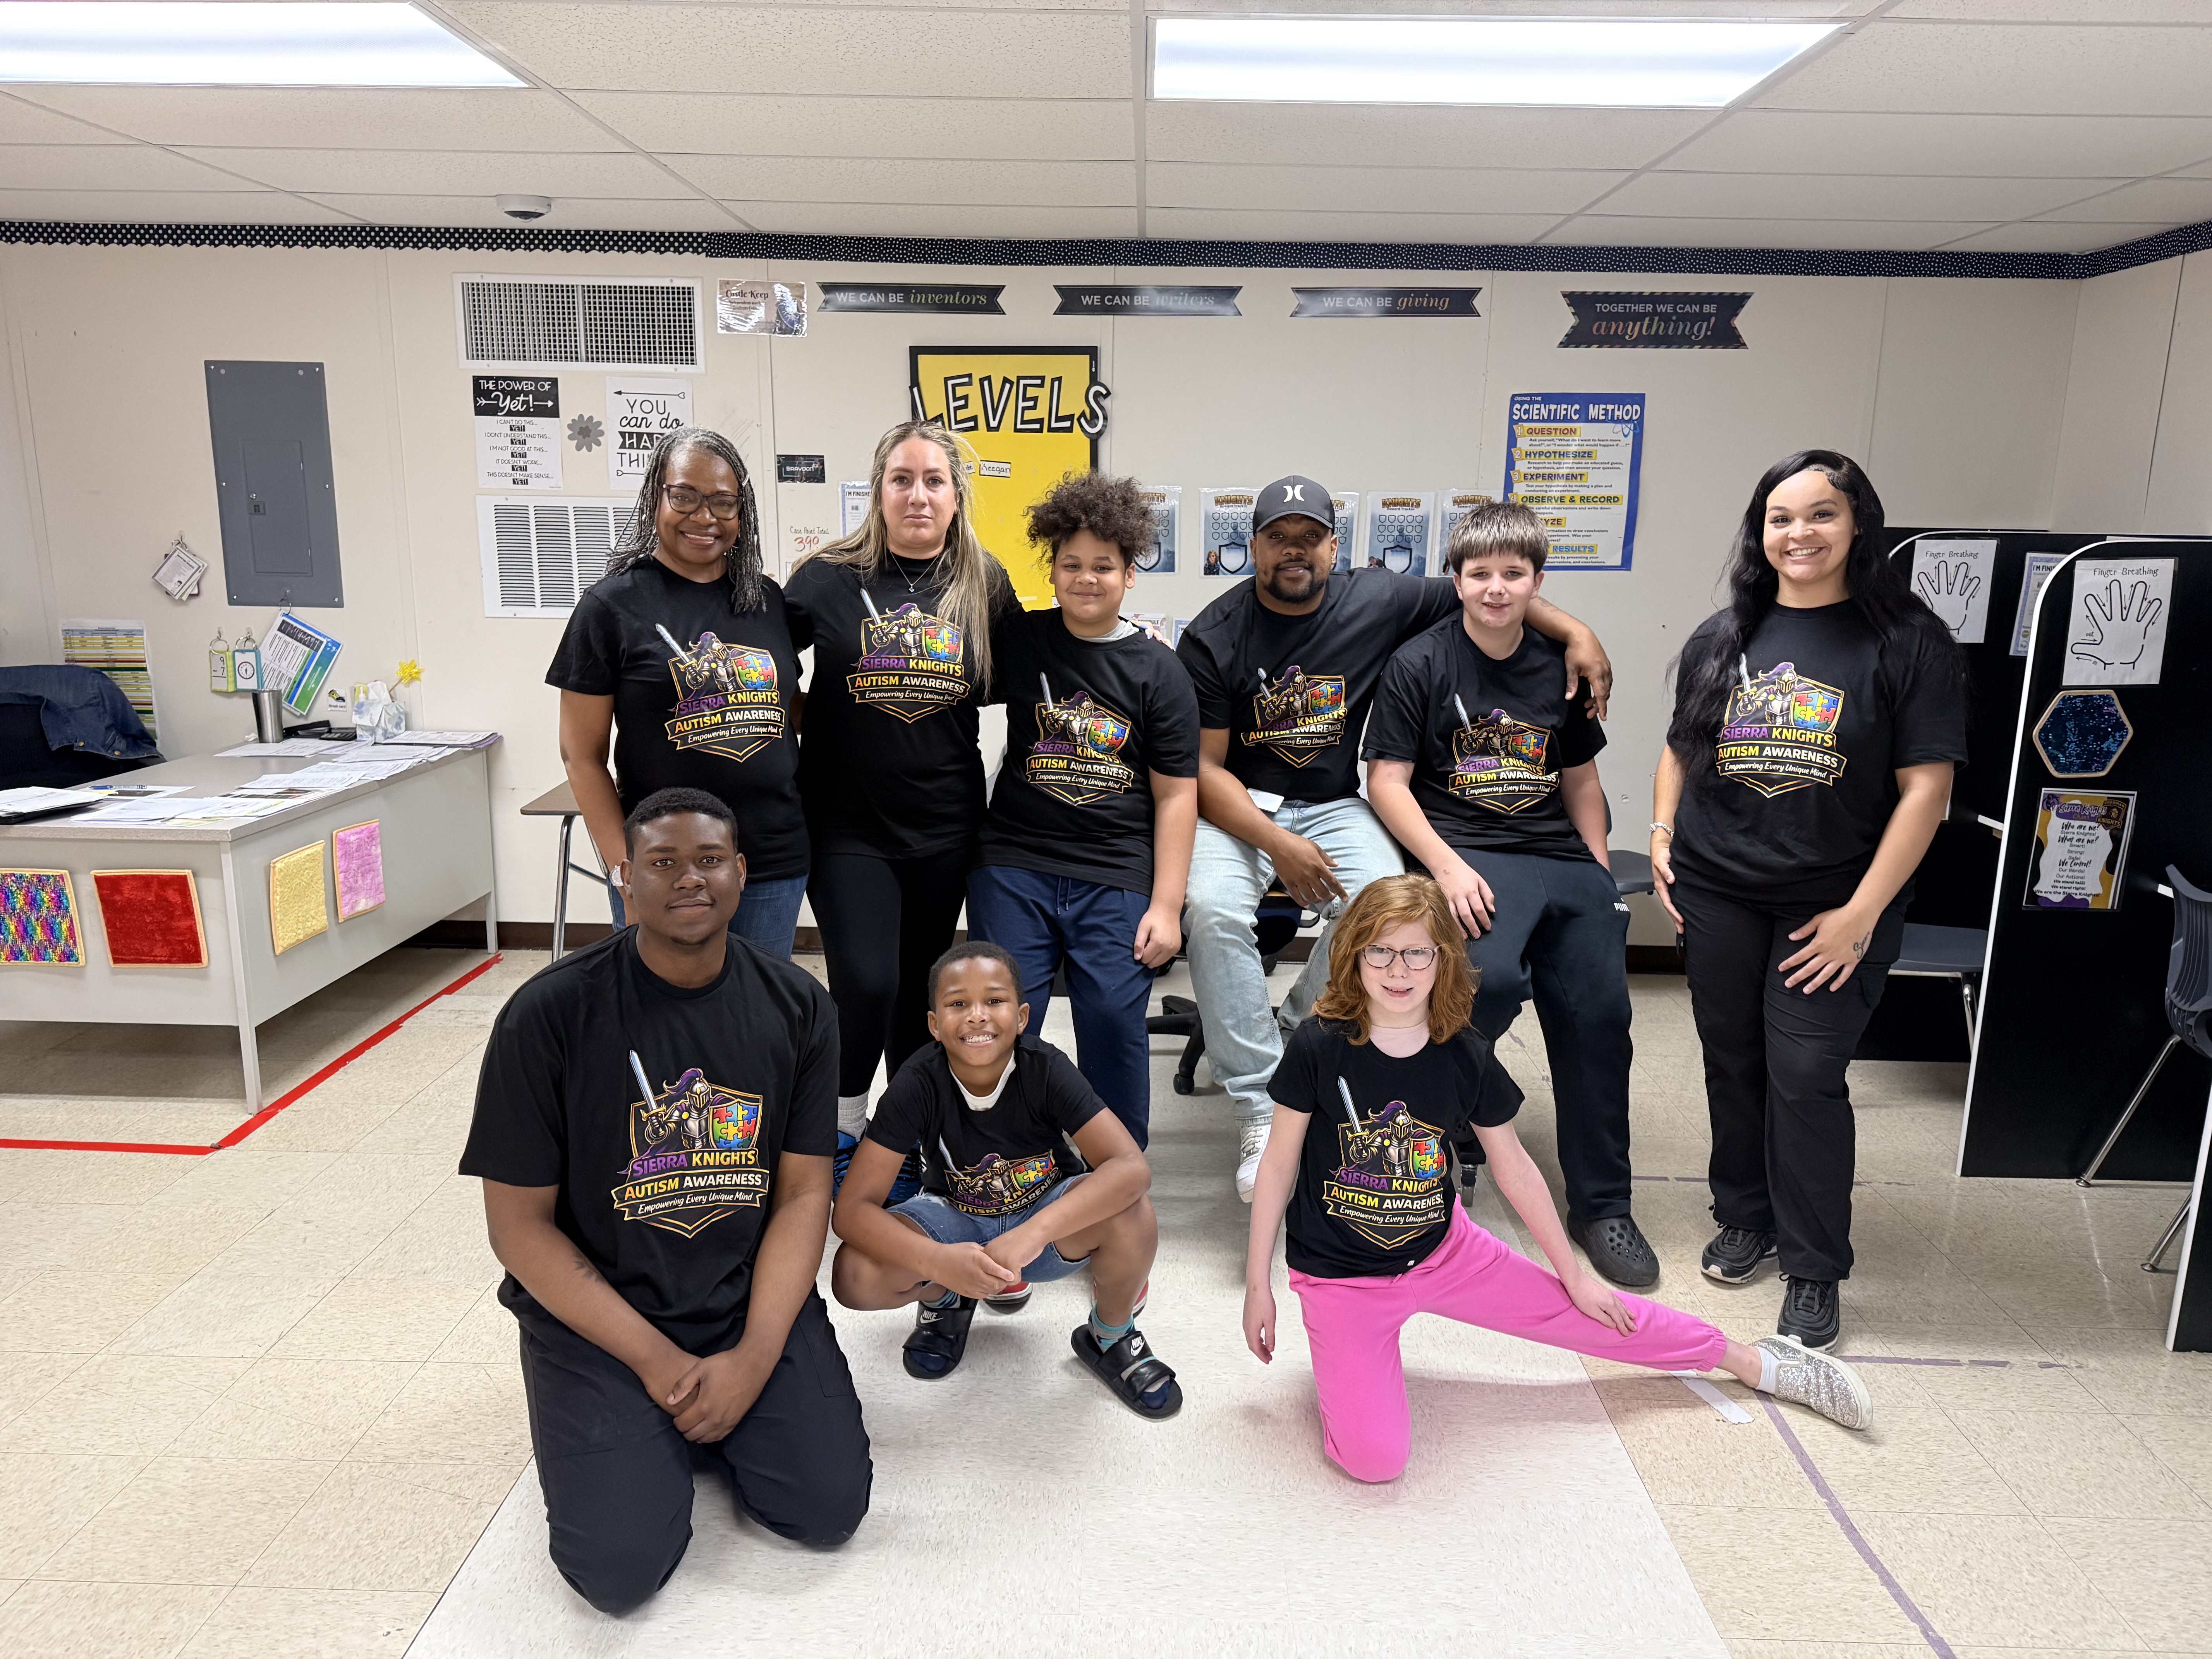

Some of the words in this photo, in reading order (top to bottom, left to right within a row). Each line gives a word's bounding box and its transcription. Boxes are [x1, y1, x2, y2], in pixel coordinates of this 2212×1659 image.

[749, 290, 769, 300] Keep
[836, 292, 855, 302] WE
[860, 292, 884, 303] CAN
[888, 293, 904, 303] BE
[909, 289, 987, 305] inventors
[1081, 295, 1101, 305] WE
[1104, 295, 1130, 305] CAN
[1134, 295, 1150, 305] BE
[1323, 297, 1343, 307] WE
[1347, 297, 1372, 307] CAN
[1377, 297, 1392, 307] BE
[1396, 293, 1450, 310] giving
[1595, 303, 1652, 313] TOGETHER
[1656, 304, 1674, 313] WE
[1676, 304, 1700, 313] CAN
[1703, 304, 1717, 313] BE
[1592, 315, 1716, 340] anything!
[479, 380, 496, 390] THE
[498, 381, 535, 391] POWER
[538, 381, 551, 391] OF
[491, 392, 534, 416] Yet!
[626, 399, 666, 415] YOU
[910, 373, 1111, 440] LEVELS
[619, 416, 652, 428] can
[659, 412, 684, 429] do
[1512, 404, 1580, 421] SCIENTIFIC
[1589, 404, 1641, 421] METHOD
[1525, 451, 1593, 459] HYPOTHESIZE
[1214, 495, 1254, 506] KNIGHTS
[1381, 497, 1422, 509] KNIGHTS
[1452, 495, 1492, 506] KNIGHTS
[794, 536, 820, 552] 390
[1926, 551, 1945, 559] Finger
[1949, 550, 1979, 559] Breathing
[2093, 568, 2117, 578] Finger
[2122, 566, 2159, 577] Breathing
[220, 656, 225, 665] 9
[862, 658, 906, 670] SIERRA
[910, 659, 962, 677] KNIGHTS
[855, 676, 899, 687] AUTISM
[902, 677, 965, 694] AWARENESS
[679, 696, 726, 714] SIERRA
[728, 691, 778, 704] KNIGHTS
[866, 691, 903, 699] Empowering
[905, 690, 922, 700] Every
[923, 692, 943, 701] Unique
[675, 714, 721, 733] AUTISM
[725, 710, 781, 722] AWARENESS
[1297, 709, 1345, 727] KNIGHTS
[688, 729, 729, 744] Empowering
[731, 726, 749, 735] Every
[750, 725, 768, 733] Unique
[1249, 730, 1290, 742] AUTISM
[1296, 738, 1311, 746] Every
[1723, 727, 1769, 741] SIERRA
[1772, 728, 1833, 747] KNIGHTS
[1036, 743, 1075, 754] SIERRA
[1718, 746, 1759, 760] AUTISM
[1762, 746, 1838, 768] AWARENESS
[1030, 759, 1067, 769] AUTISM
[1070, 761, 1129, 779] AWARENESS
[1458, 759, 1499, 772] SIERRA
[1501, 757, 1543, 776] KNIGHTS
[1725, 762, 1763, 771] Empowering
[1764, 762, 1785, 772] Every
[1785, 764, 1810, 775] Unique
[1810, 769, 1827, 778] Mind
[1036, 773, 1071, 783] Empowering
[1072, 775, 1088, 785] Every
[1088, 778, 1108, 788] Unique
[1107, 781, 1121, 789] Mind
[1455, 773, 1497, 787] AUTISM
[1466, 786, 1502, 796] Empowering
[1503, 784, 1519, 792] Every
[1520, 784, 1538, 793] Unique
[2097, 817, 2121, 827] KNIGHTS
[1614, 903, 1630, 912] PUM
[632, 1152, 688, 1177] SIERRA
[692, 1150, 756, 1167] KNIGHTS
[624, 1177, 679, 1200] AUTISM
[683, 1174, 762, 1188] AWARENESS
[1339, 1170, 1389, 1190] SIERRA
[1392, 1178, 1438, 1193] KNIGHTS
[637, 1198, 685, 1214] Empowering
[685, 1193, 707, 1205] Every
[708, 1192, 733, 1202] Unique
[734, 1192, 754, 1201] Mind
[1331, 1186, 1379, 1208] AUTISM
[1340, 1205, 1384, 1224] Empowering
[1385, 1214, 1405, 1224] Every
[1405, 1214, 1427, 1224] Unique
[1427, 1210, 1440, 1221] Mind
[923, 1310, 938, 1320] NIKE
[1132, 1336, 1142, 1349] NIKE
